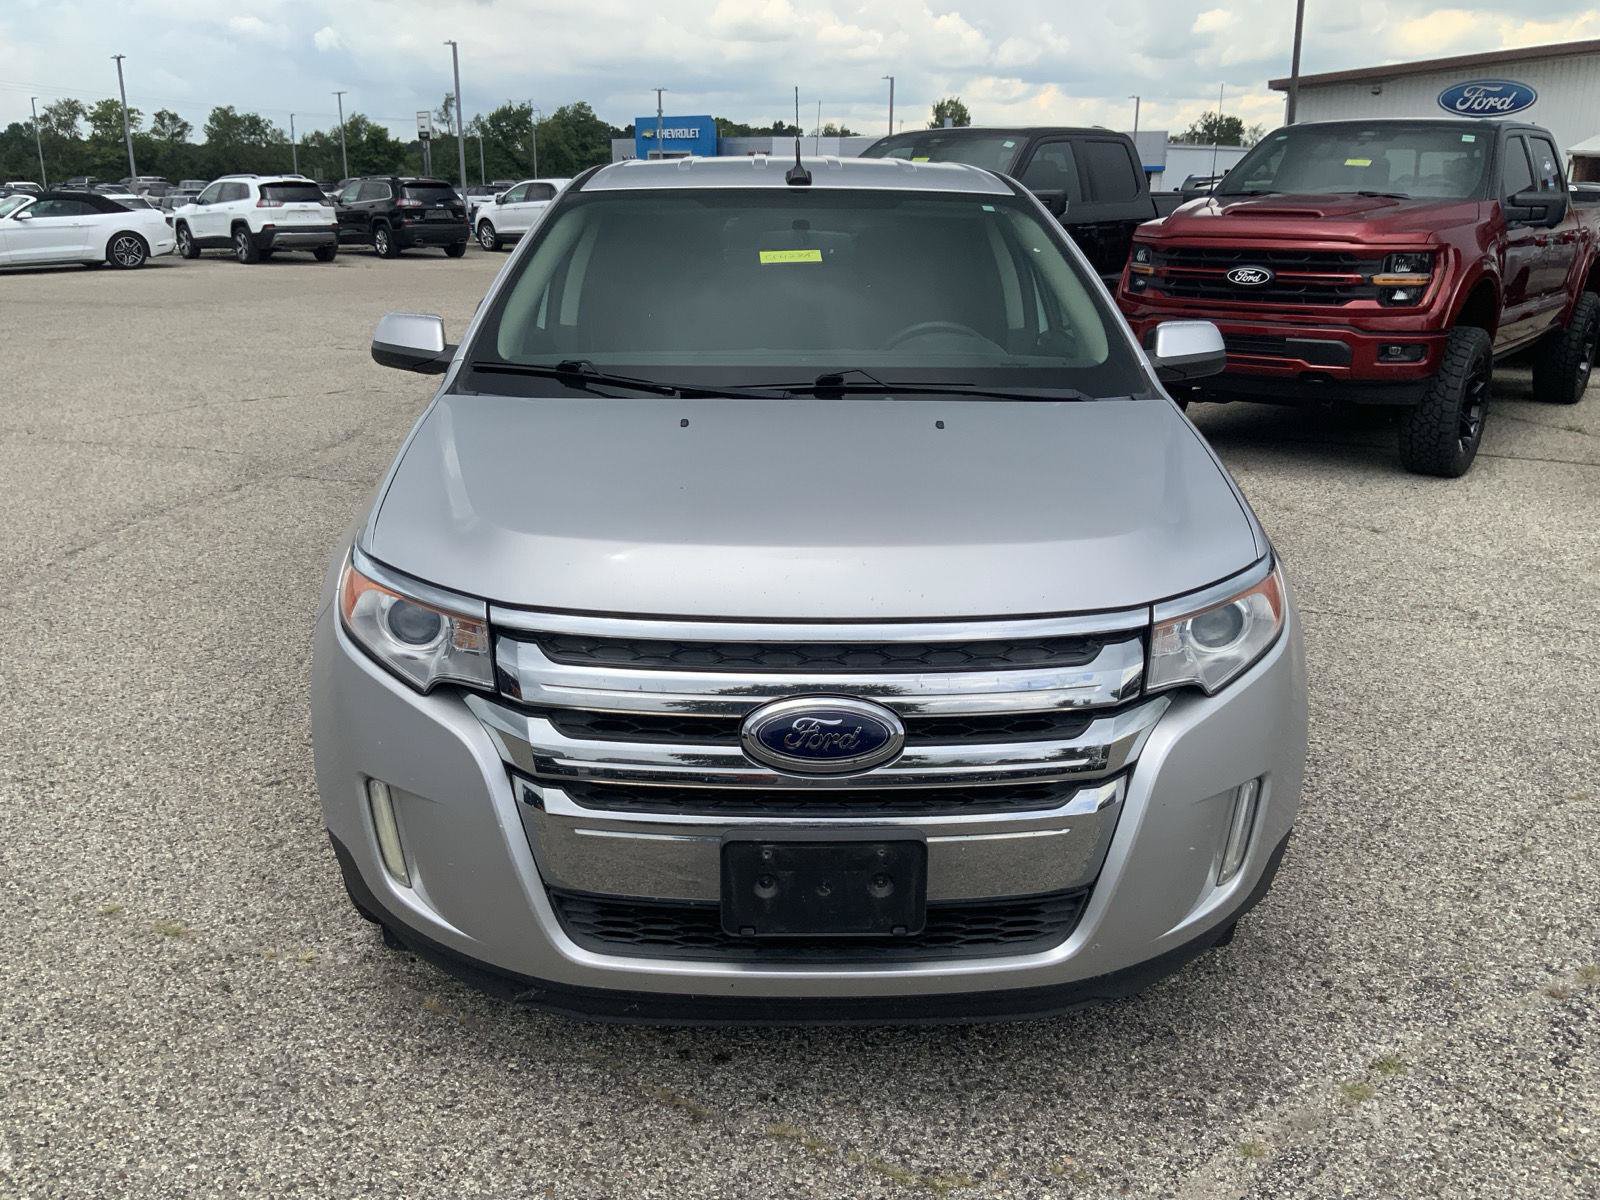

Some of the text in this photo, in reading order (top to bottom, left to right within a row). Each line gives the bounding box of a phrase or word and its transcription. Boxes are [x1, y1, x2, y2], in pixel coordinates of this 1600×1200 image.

[1455, 85, 1517, 110] Ford
[656, 128, 700, 139] CHEVROLET
[1234, 270, 1262, 282] Ford
[783, 716, 863, 752] Ford
